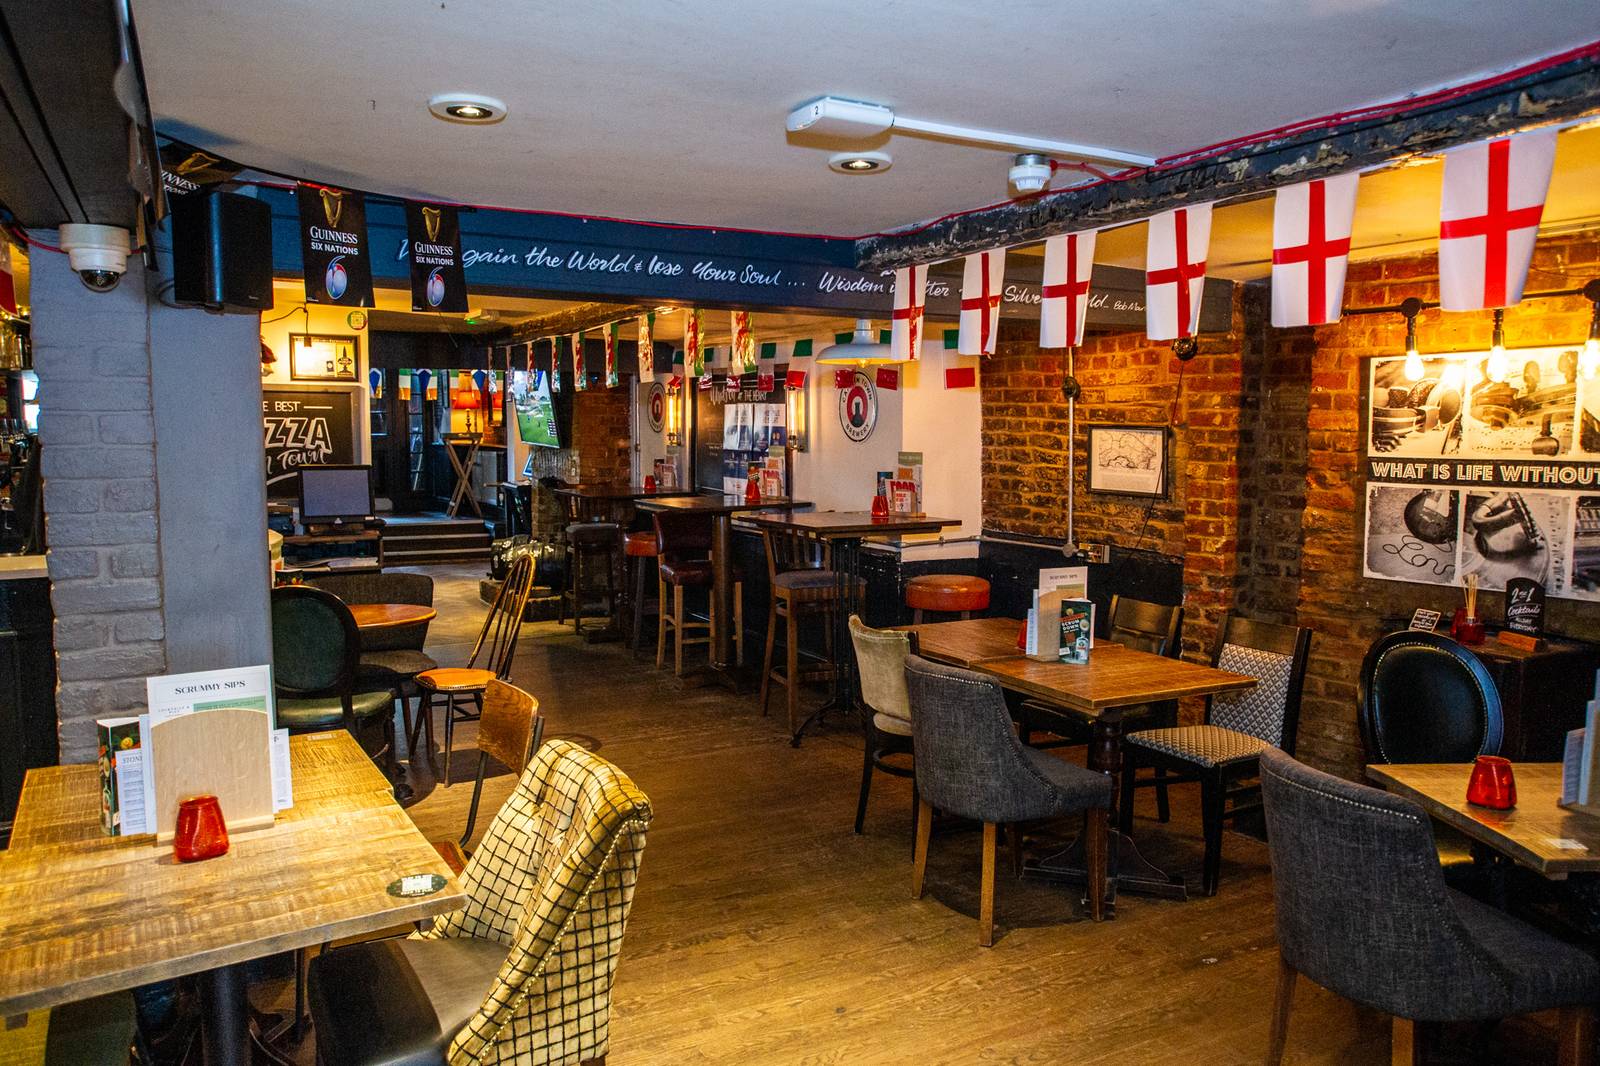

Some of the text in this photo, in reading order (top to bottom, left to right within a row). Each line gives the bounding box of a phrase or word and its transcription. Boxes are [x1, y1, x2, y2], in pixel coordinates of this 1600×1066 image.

[161, 169, 200, 190] INNESS
[310, 225, 358, 245] GUINNESS
[311, 241, 359, 256] SIX NATIONS
[414, 241, 453, 256] GUINNESS
[415, 256, 454, 266] SIX NATIONS
[462, 248, 519, 268] gain
[524, 246, 564, 268] the
[567, 251, 635, 272] World
[648, 255, 684, 275] lose
[692, 261, 737, 281] Your
[740, 264, 782, 286] Soul
[819, 271, 884, 292] Wisdom
[1004, 285, 1041, 305] Silve
[275, 401, 301, 411] BEST
[263, 417, 333, 454] ZZA
[277, 449, 327, 470] Town
[1371, 462, 1427, 478] WHAT
[1432, 464, 1450, 479] IS
[1456, 464, 1494, 481] LIFE
[1511, 587, 1520, 604] 2
[1061, 619, 1080, 627] SCRUM
[174, 680, 246, 695] SCRUMMY SIPS
